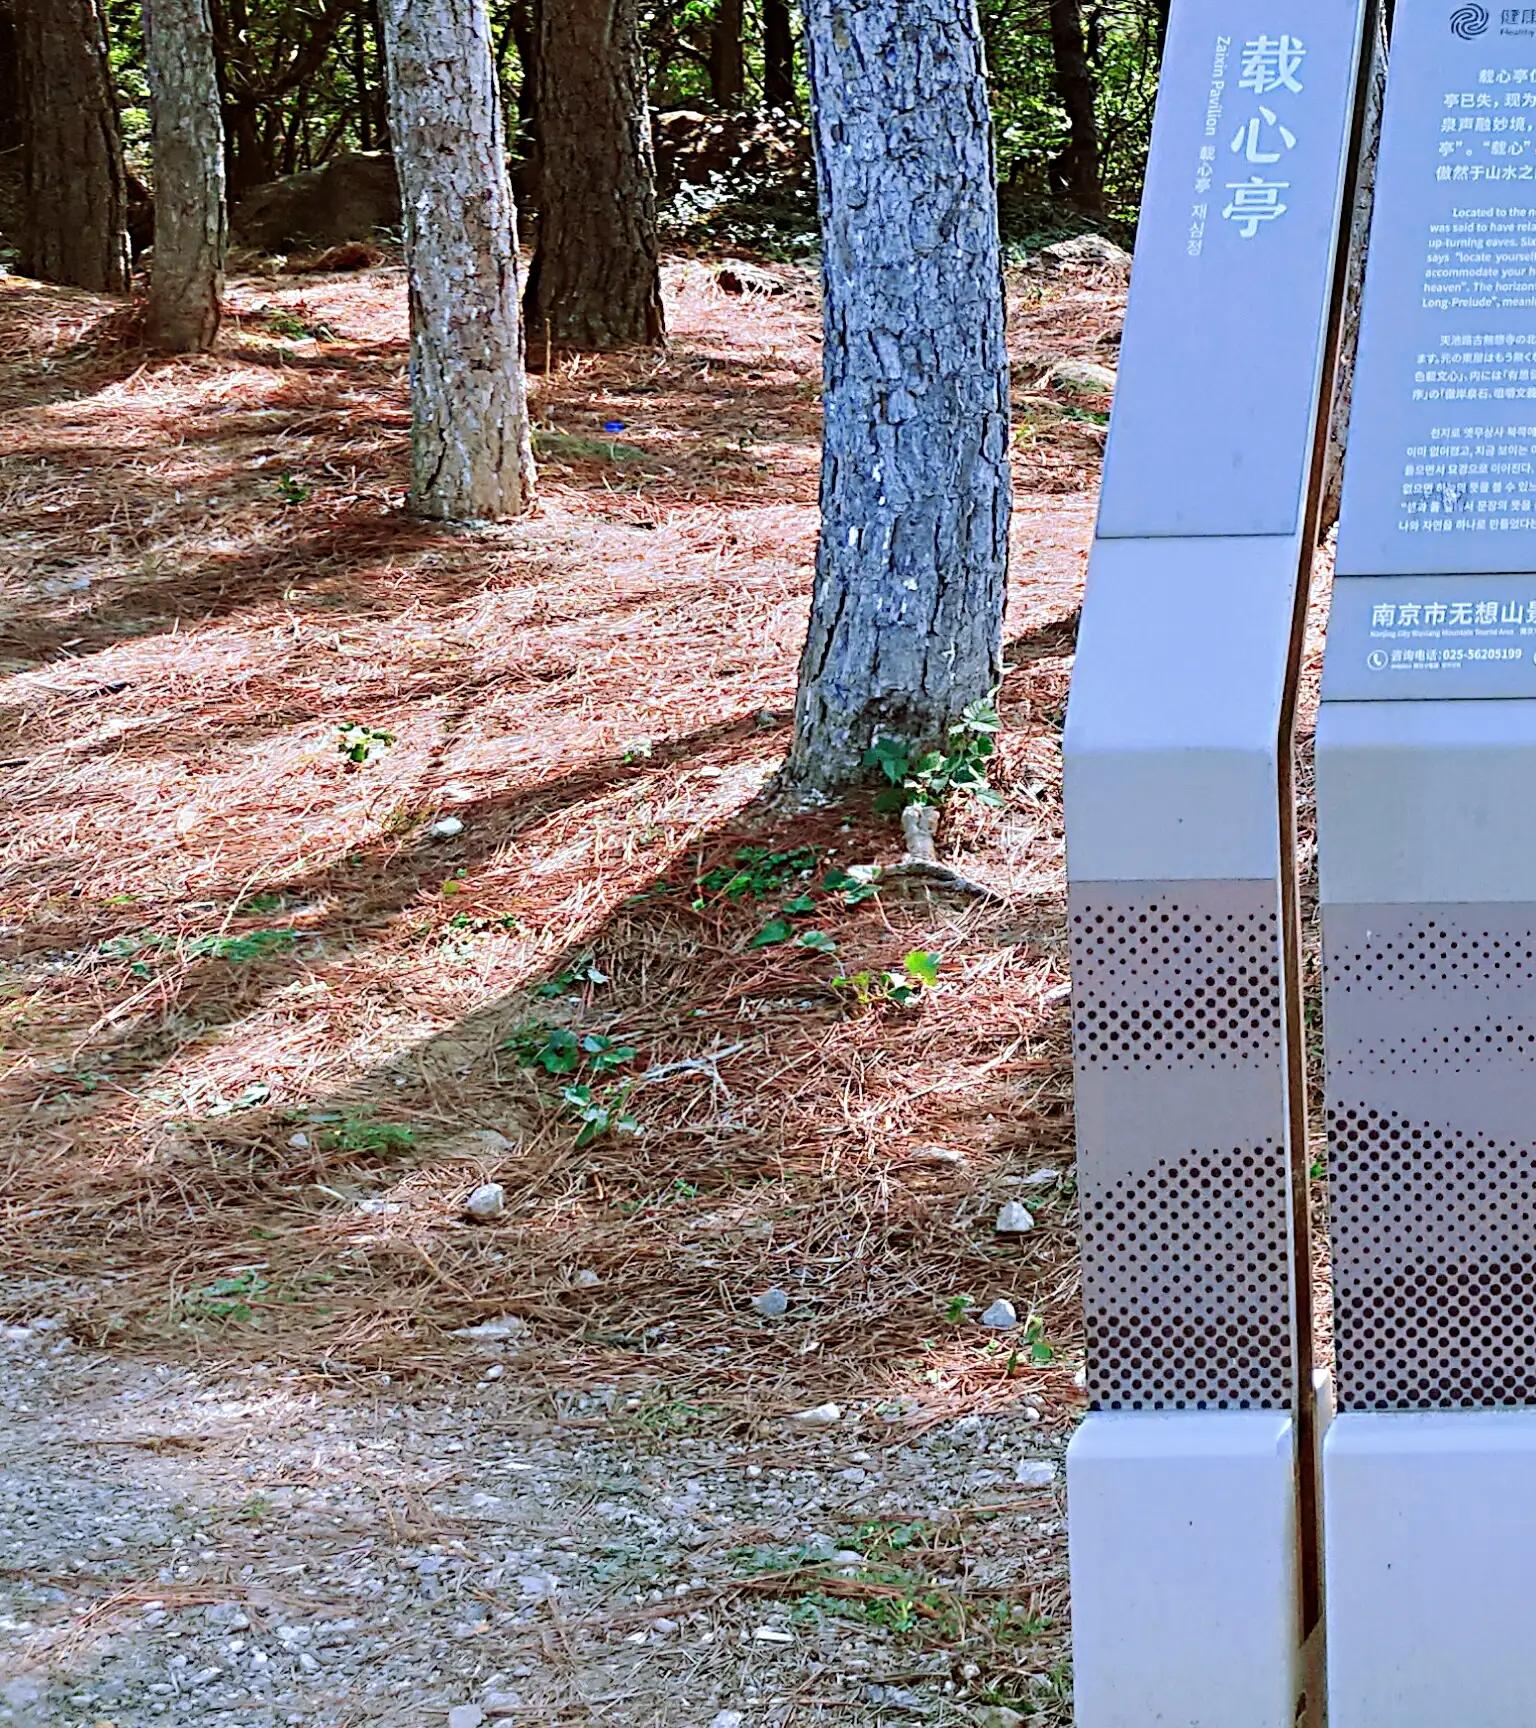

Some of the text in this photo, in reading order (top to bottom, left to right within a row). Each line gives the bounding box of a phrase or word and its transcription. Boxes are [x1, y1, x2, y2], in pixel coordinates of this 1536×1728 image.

[1205, 35, 1231, 136] Zaixin Pavilion
[1222, 34, 1306, 238] 载心亭
[1452, 207, 1493, 218] Located
[1495, 207, 1507, 217] to
[1508, 206, 1526, 217] the
[1429, 224, 1450, 232] was
[1452, 222, 1474, 232] said
[1476, 223, 1487, 232] to
[1489, 221, 1514, 232] have
[1428, 237, 1483, 249] up-turning
[1520, 236, 1536, 247] Six
[1426, 253, 1449, 264] says
[1425, 267, 1498, 278] accommodate
[1501, 267, 1526, 278] your
[1473, 281, 1492, 292] The
